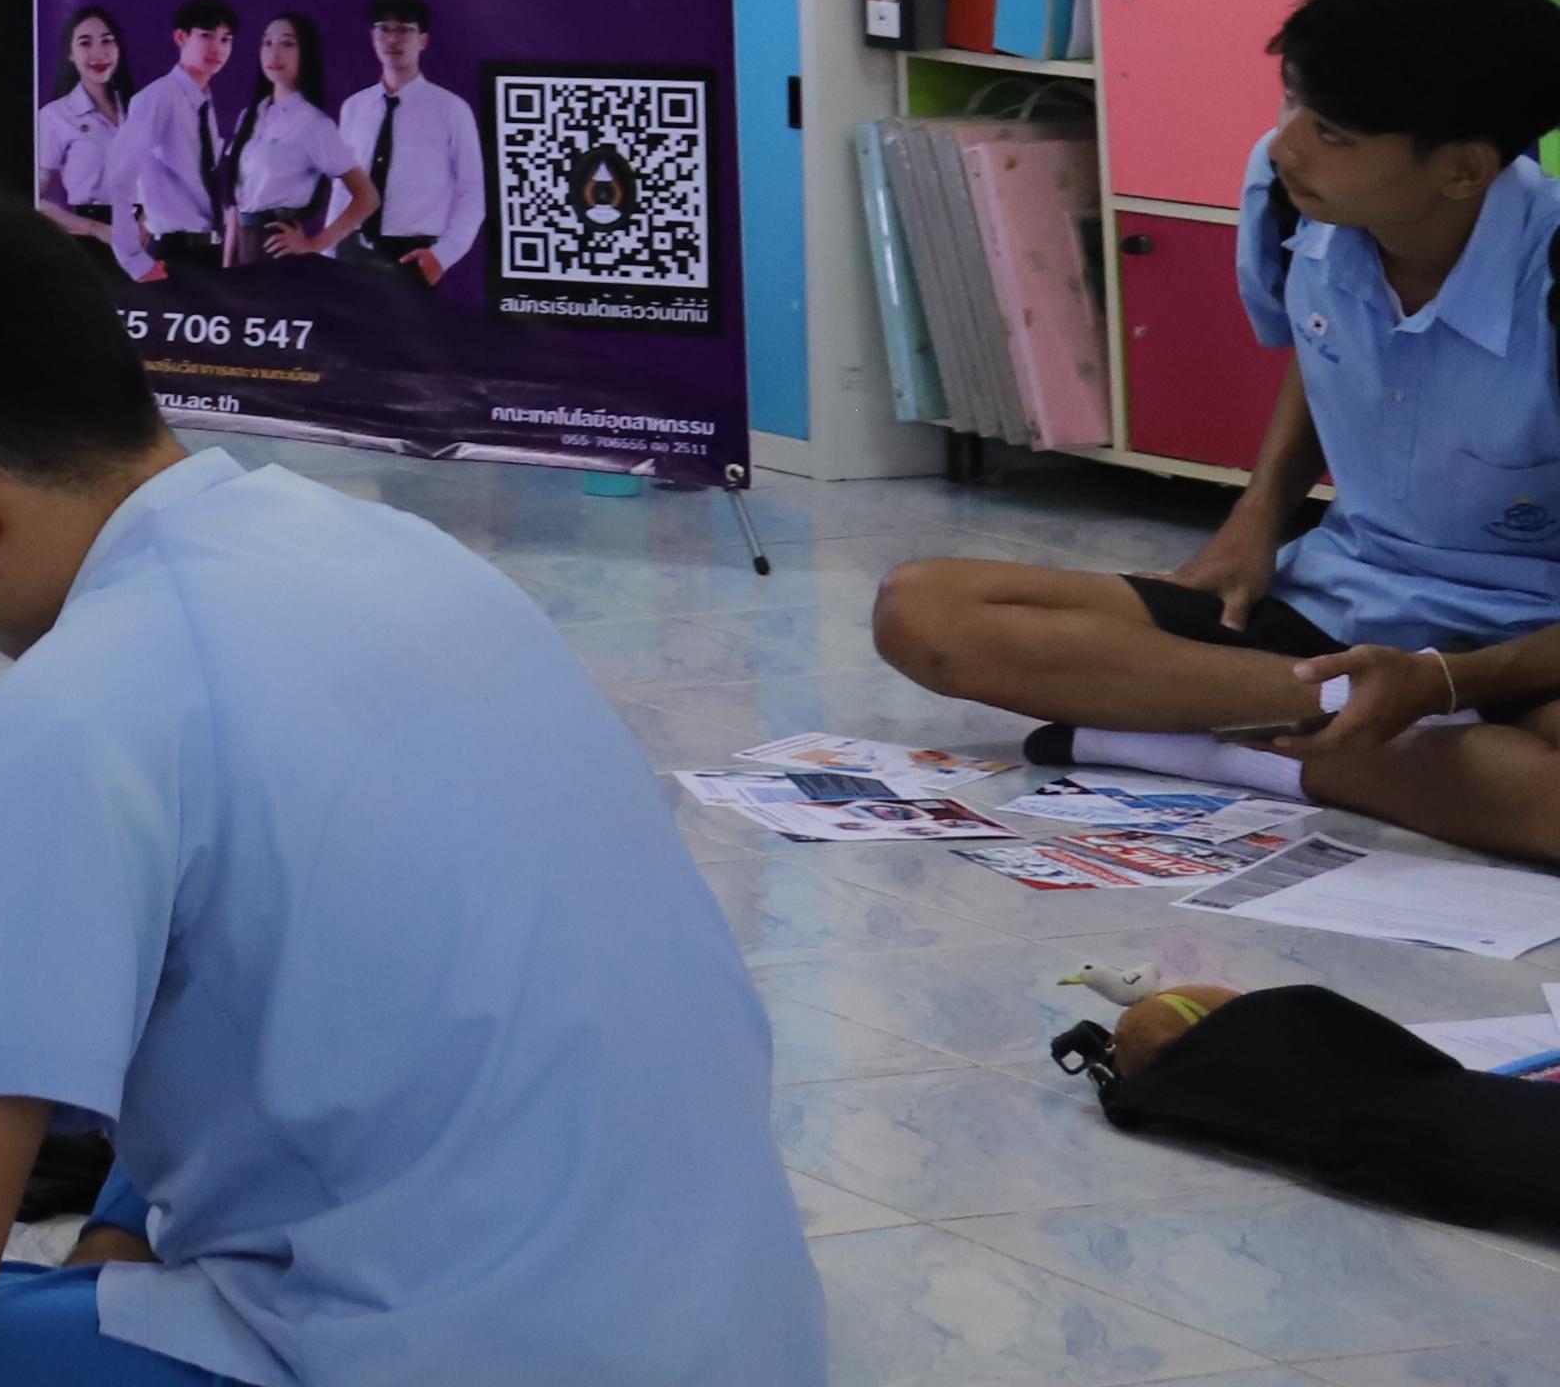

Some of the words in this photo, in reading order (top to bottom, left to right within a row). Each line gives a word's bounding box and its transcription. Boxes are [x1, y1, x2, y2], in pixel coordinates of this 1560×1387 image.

[498, 291, 710, 324] สมัครเรียนได้แล้ววันนี้ที่นี่
[161, 312, 232, 346] 706
[243, 317, 314, 352] 547
[490, 404, 716, 437] คณะเทคโนโลยีอุตสาหกรรม
